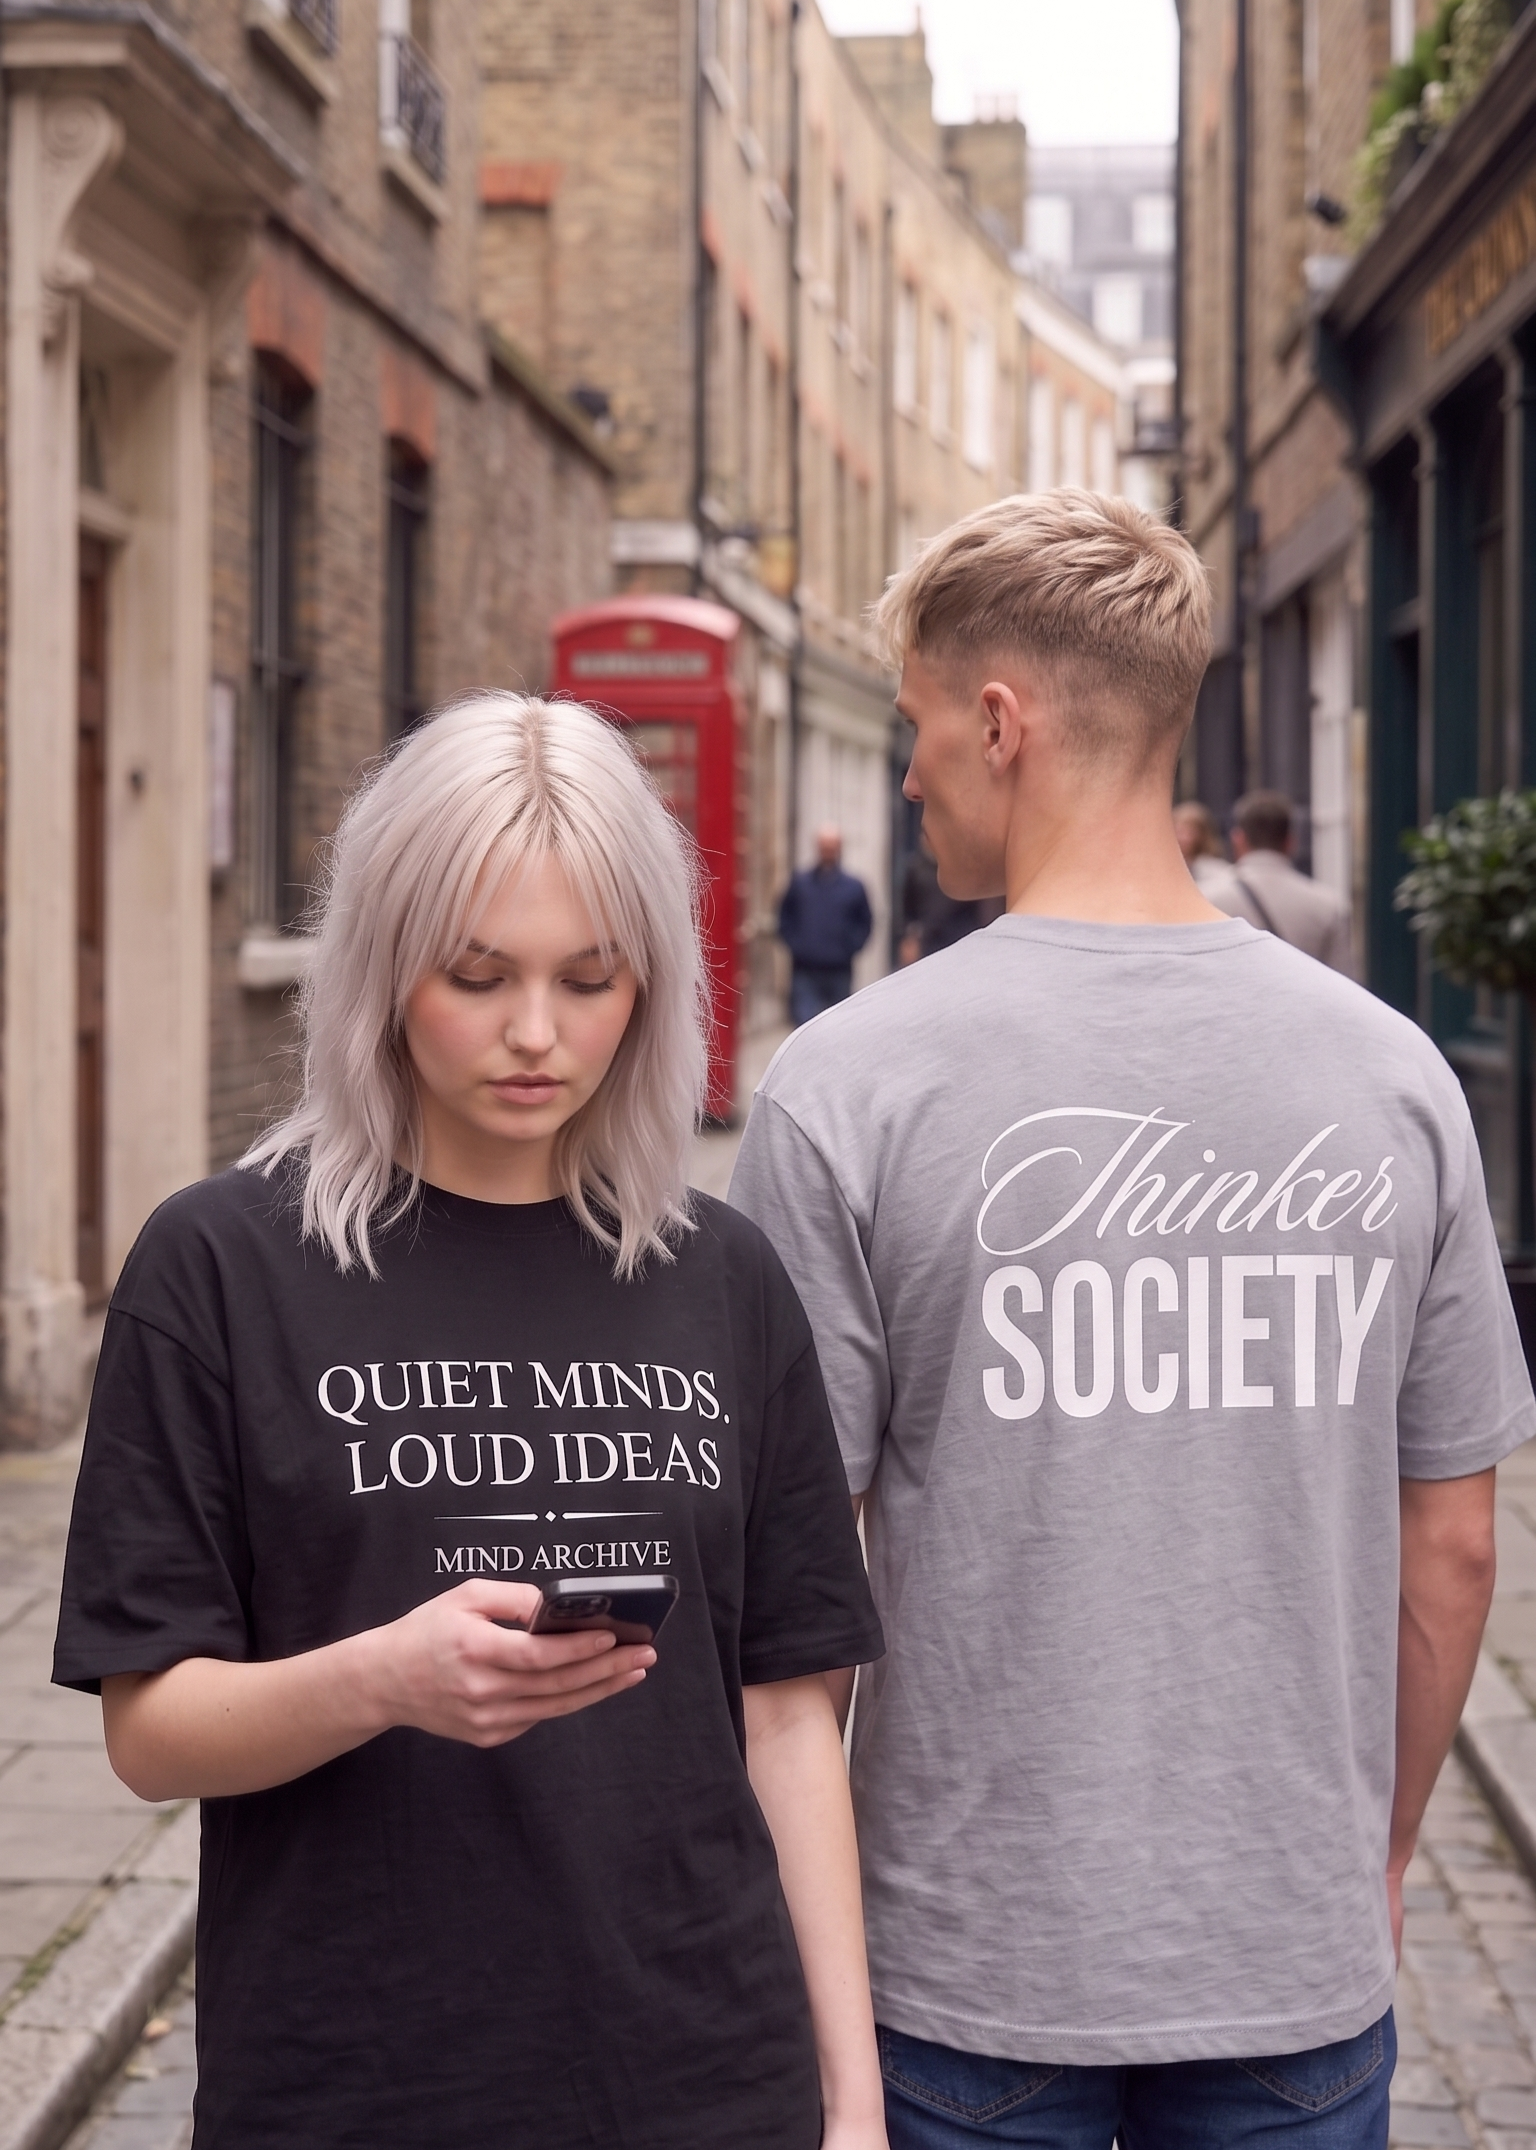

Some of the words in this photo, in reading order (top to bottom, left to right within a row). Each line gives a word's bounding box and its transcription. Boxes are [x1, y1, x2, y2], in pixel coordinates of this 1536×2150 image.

[976, 1106, 1398, 1256] Thinker
[981, 1254, 1395, 1420] SOCIETY
[317, 1360, 513, 1426] QUIET
[528, 1360, 731, 1424] MINDS.
[344, 1433, 535, 1495] LOUD
[549, 1432, 721, 1490] IDEAS
[434, 1546, 524, 1573] MIND
[530, 1540, 672, 1571] ARCHIVE
